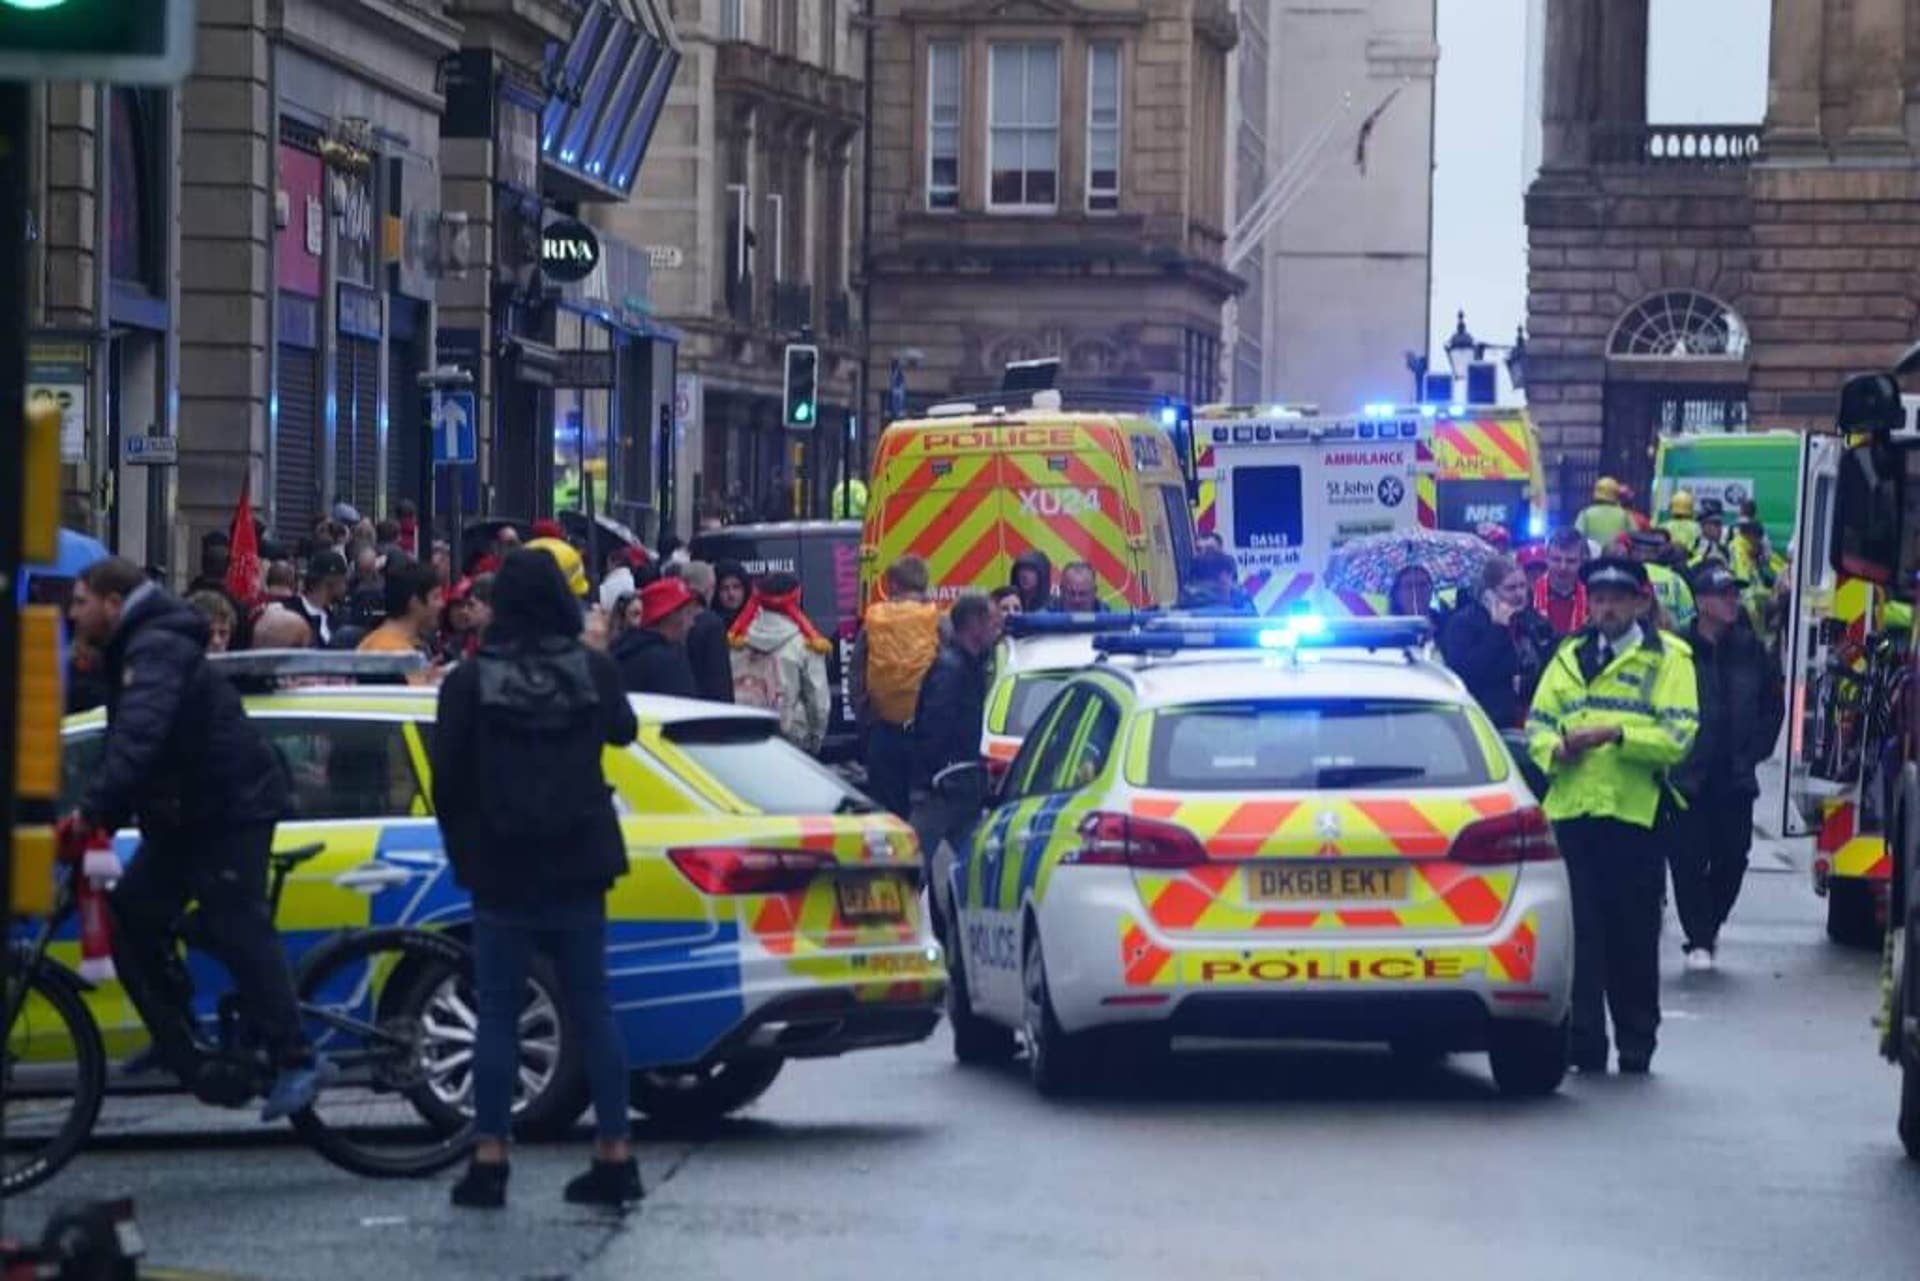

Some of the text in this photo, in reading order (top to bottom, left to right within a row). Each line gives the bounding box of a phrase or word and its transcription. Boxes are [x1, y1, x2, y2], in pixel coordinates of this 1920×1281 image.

[542, 239, 593, 259] RIVA
[923, 428, 1076, 451] POLICE
[1324, 451, 1404, 466] AMBULANCE
[1019, 488, 1101, 516] XU24
[1465, 504, 1507, 521] NHS
[1259, 868, 1395, 896] DK68 EKT
[1201, 957, 1465, 983] POLICE
